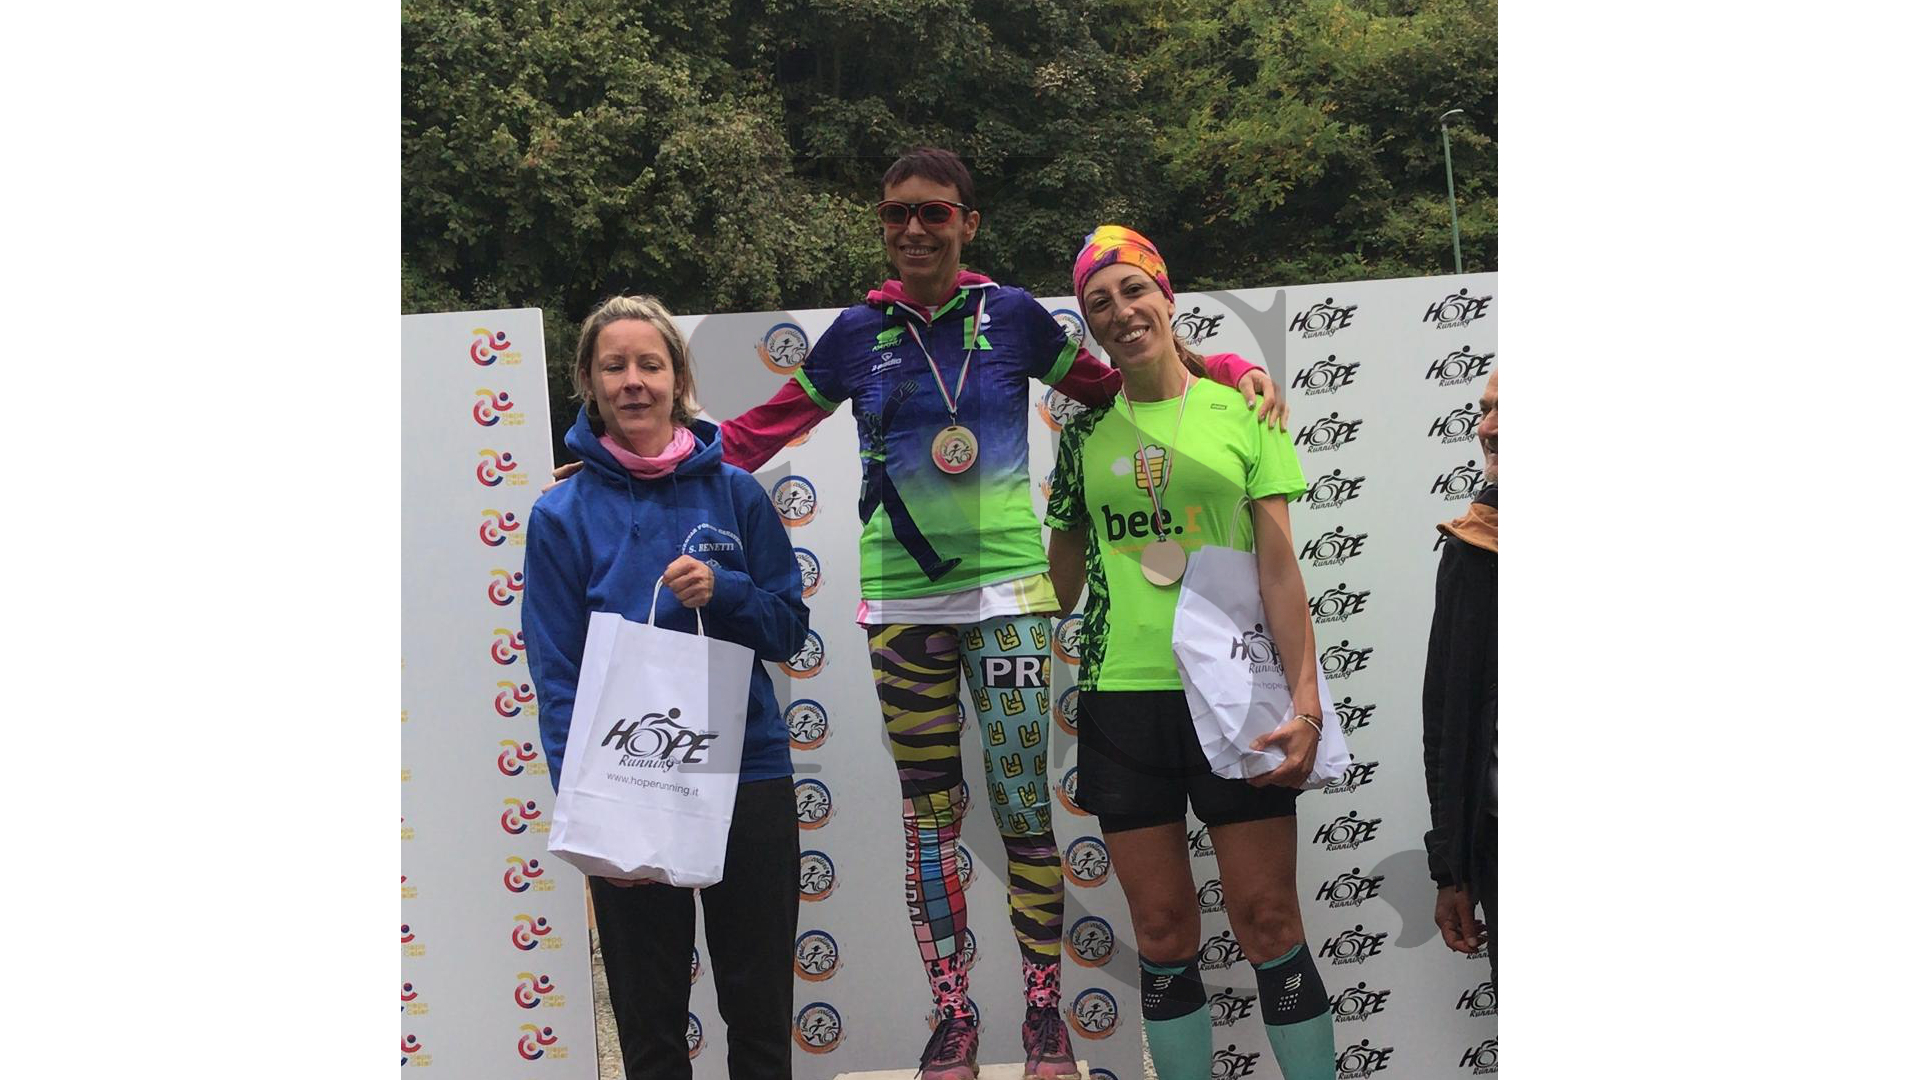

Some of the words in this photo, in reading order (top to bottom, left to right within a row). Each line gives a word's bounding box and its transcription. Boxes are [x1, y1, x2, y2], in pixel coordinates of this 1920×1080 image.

[1289, 302, 1358, 332] HOPE
[1422, 294, 1493, 322] HOPE
[1171, 312, 1225, 340] OPE
[1291, 360, 1361, 389] HOPE
[1425, 352, 1495, 380] HOPE
[1294, 417, 1363, 446] HOPE
[1297, 474, 1366, 503] HOPE
[1299, 532, 1368, 560] HOPE
[1320, 646, 1374, 674] OPE
[600, 717, 720, 764] HOPE
[618, 754, 675, 773] Running
[606, 771, 700, 797] www.hoperunning.it
[1313, 817, 1382, 844] HOPE
[1315, 874, 1385, 901] HOPE
[1318, 931, 1389, 958] HOPE
[1208, 994, 1258, 1019] OPE
[1211, 1051, 1261, 1078] OPE
